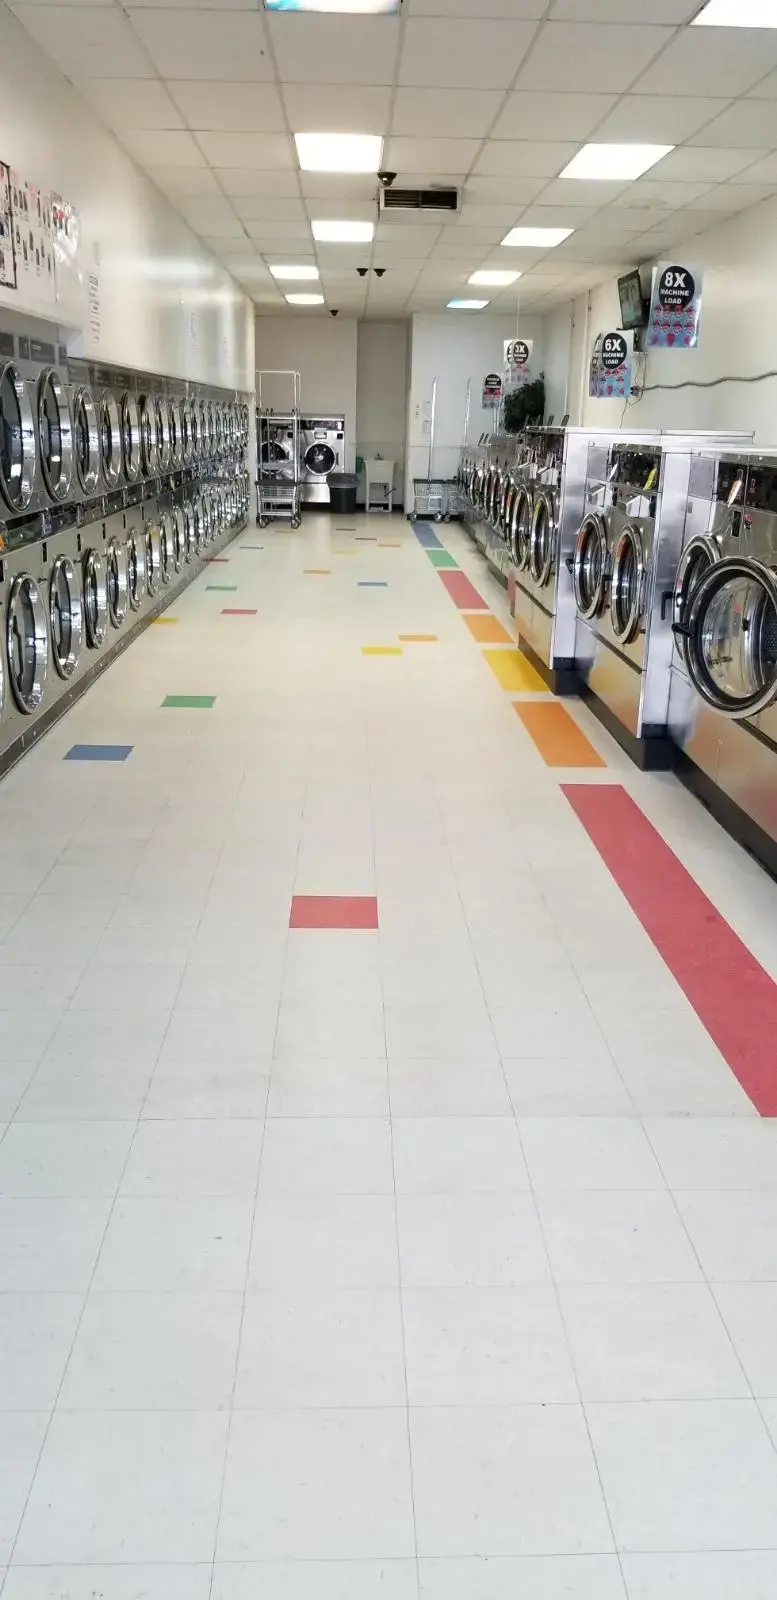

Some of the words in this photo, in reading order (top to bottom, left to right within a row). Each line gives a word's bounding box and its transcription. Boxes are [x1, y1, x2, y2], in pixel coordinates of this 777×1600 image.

[665, 272, 686, 287] 8X
[514, 345, 525, 353] 3X
[605, 339, 621, 351] 6X
